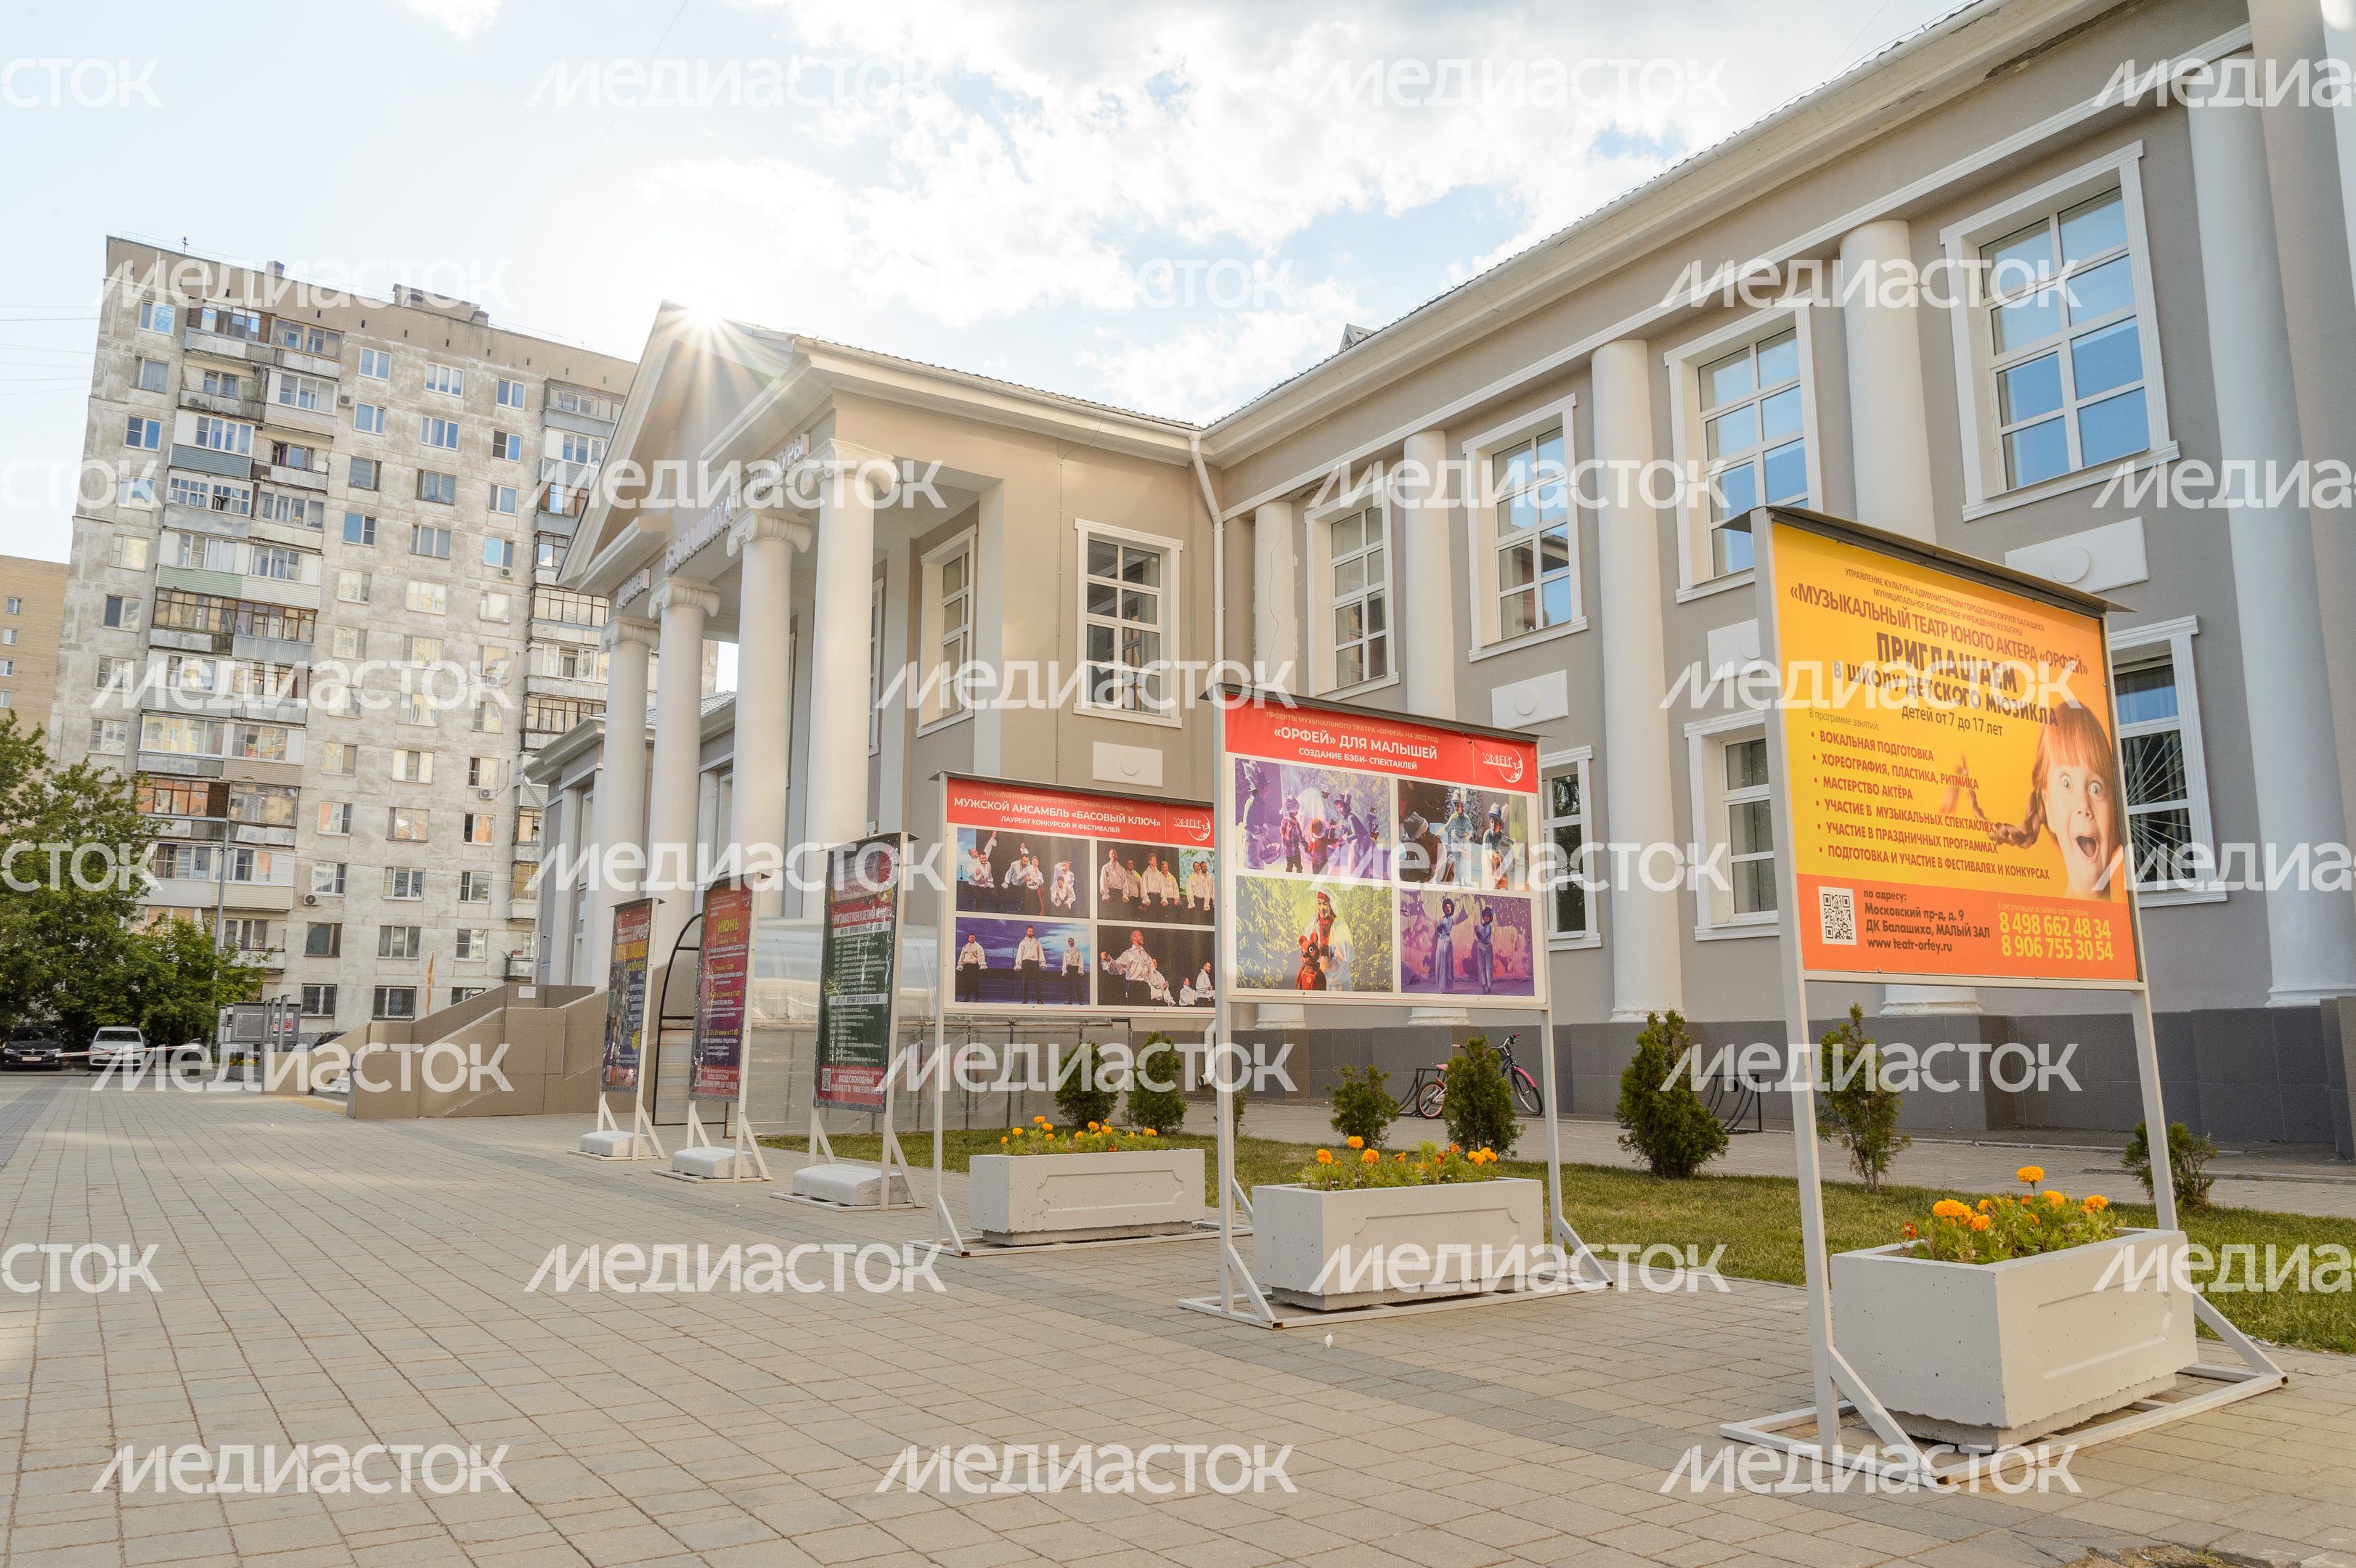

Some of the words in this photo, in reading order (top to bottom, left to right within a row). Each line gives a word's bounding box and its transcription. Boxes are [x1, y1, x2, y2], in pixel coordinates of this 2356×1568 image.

[1845, 568, 1883, 585] УПРАВЛЕНИЕ
[1884, 579, 1914, 594] КУЛЬТУРЫ
[1915, 589, 1964, 608] АДМИНИСТРАЦИИ
[1965, 603, 1997, 618] ГОРОДСКОГО
[1998, 612, 2016, 623] ОКРУГА
[2017, 617, 2045, 632] БАЛАШИХА
[1873, 589, 1925, 608] МУНИЦИПАЛЬНОЕ
[1926, 604, 1961, 619] БЮДЖЕТНОЕ
[1962, 613, 1996, 629] УЧРЕЖДЕНИЕ
[1997, 623, 2023, 636] КУЛЬТУРЫ
[1790, 583, 1911, 629] «МУЗЫКАЛЬНЫЙ
[1912, 613, 1948, 639] ТЕАТР
[1951, 624, 1994, 651] ЮНОГО
[1997, 637, 2037, 663] АКТЕРА
[2040, 650, 2088, 674] «ОРФЕЙ»
[1876, 632, 2018, 693] ПРИГЛАШАЕМ
[1833, 661, 1841, 679] В
[1847, 664, 1900, 692] ШКОЛУ
[1905, 671, 1981, 709] ДЕТСКОГО
[1986, 693, 2058, 726] МЮЗИКЛА
[1266, 712, 1297, 722] ПРОЕКТЫ
[1299, 716, 1351, 730] МУЗЫКАЛЬНОГО
[1353, 724, 1375, 733] ТЕАТРА
[1377, 728, 1404, 737] «ОРФЕЙ»
[1809, 709, 1814, 719] В
[1815, 712, 1851, 727] программе
[1853, 718, 1880, 730] занятий:
[1902, 705, 1933, 723] детей
[1936, 713, 1947, 725] от
[1949, 712, 1954, 726] 7
[1957, 717, 1971, 731] до
[1973, 717, 1984, 732] 17
[1987, 723, 2003, 736] лет
[1274, 727, 1336, 745] «ОРФЕЙ»
[1340, 735, 1366, 749] ДЛЯ
[1371, 739, 1438, 759] МАЛЫШЕЙ
[1820, 730, 1875, 751] ВОКАЛЬНАЯ
[1878, 741, 1934, 761] ПОДГОТОВКА
[1299, 748, 1342, 760] СОЗДАНИЕ
[1369, 757, 1417, 769] СПЕКТАКЛЕЙ
[1821, 753, 1890, 777] ХОРЕОГРАФИЯ,
[1892, 765, 1939, 785] ПЛАСТИКА,
[1941, 773, 1979, 790] РИТМИКА
[1012, 794, 1056, 804] МУЗЫКАЛЬНОГО
[1823, 776, 1879, 796] МАСТЕРСТВО
[1882, 784, 1913, 800] АКТЁРА
[954, 798, 1009, 811] МУЖСКОЙ
[1012, 804, 1069, 817] АНСАМБЛЬ
[1072, 812, 1125, 823] «БАСОВЫЙ
[1128, 817, 1160, 826] КЛЮЧ»
[1825, 799, 1864, 815] УЧАСТИЕ
[1867, 804, 1872, 816] В
[1876, 806, 1943, 826] МУЗЫКАЛЬНЫХ
[1032, 819, 1070, 828] КОНКУРСОВ
[1078, 823, 1120, 833] ФЕСТИВАЛЕЙ
[1826, 822, 1866, 838] УЧАСТИЕ
[1868, 827, 1874, 839] В
[1876, 828, 1941, 848] ПРАЗДНИЧНЫХ
[1943, 838, 1998, 854] ПРОГРАММАХ
[1828, 845, 1888, 863] ПОДГОТОВКА
[1891, 852, 1898, 864] И
[1899, 854, 1936, 868] УЧАСТИЕ
[1939, 858, 1943, 869] В
[1945, 858, 1996, 874] ФЕСТИВАЛЯХ
[1997, 864, 2003, 875] И
[2005, 865, 2050, 880] КОНКУРСАХ
[1876, 891, 1907, 903] адресу:
[1865, 902, 1921, 918] Московский
[1924, 910, 1946, 922] пр-д,
[1949, 912, 1956, 921] д.
[1959, 910, 1964, 920] 9
[1999, 912, 2010, 934] 8
[2013, 913, 2041, 935] 498
[2044, 915, 2071, 936] 662
[2074, 918, 2092, 939] 48
[2093, 919, 2111, 939] 34
[717, 918, 739, 934] ИЮНЬ
[1867, 919, 1880, 933] ДК
[1883, 920, 1934, 936] Балашиха,
[1936, 923, 1970, 936] МАЛЫЙ
[1974, 926, 1990, 938] ЗАЛ
[2001, 934, 2012, 957] 8
[2015, 936, 2043, 957] 906
[2045, 938, 2074, 959] 755
[2076, 939, 2093, 960] 30
[2096, 941, 2114, 961] 54
